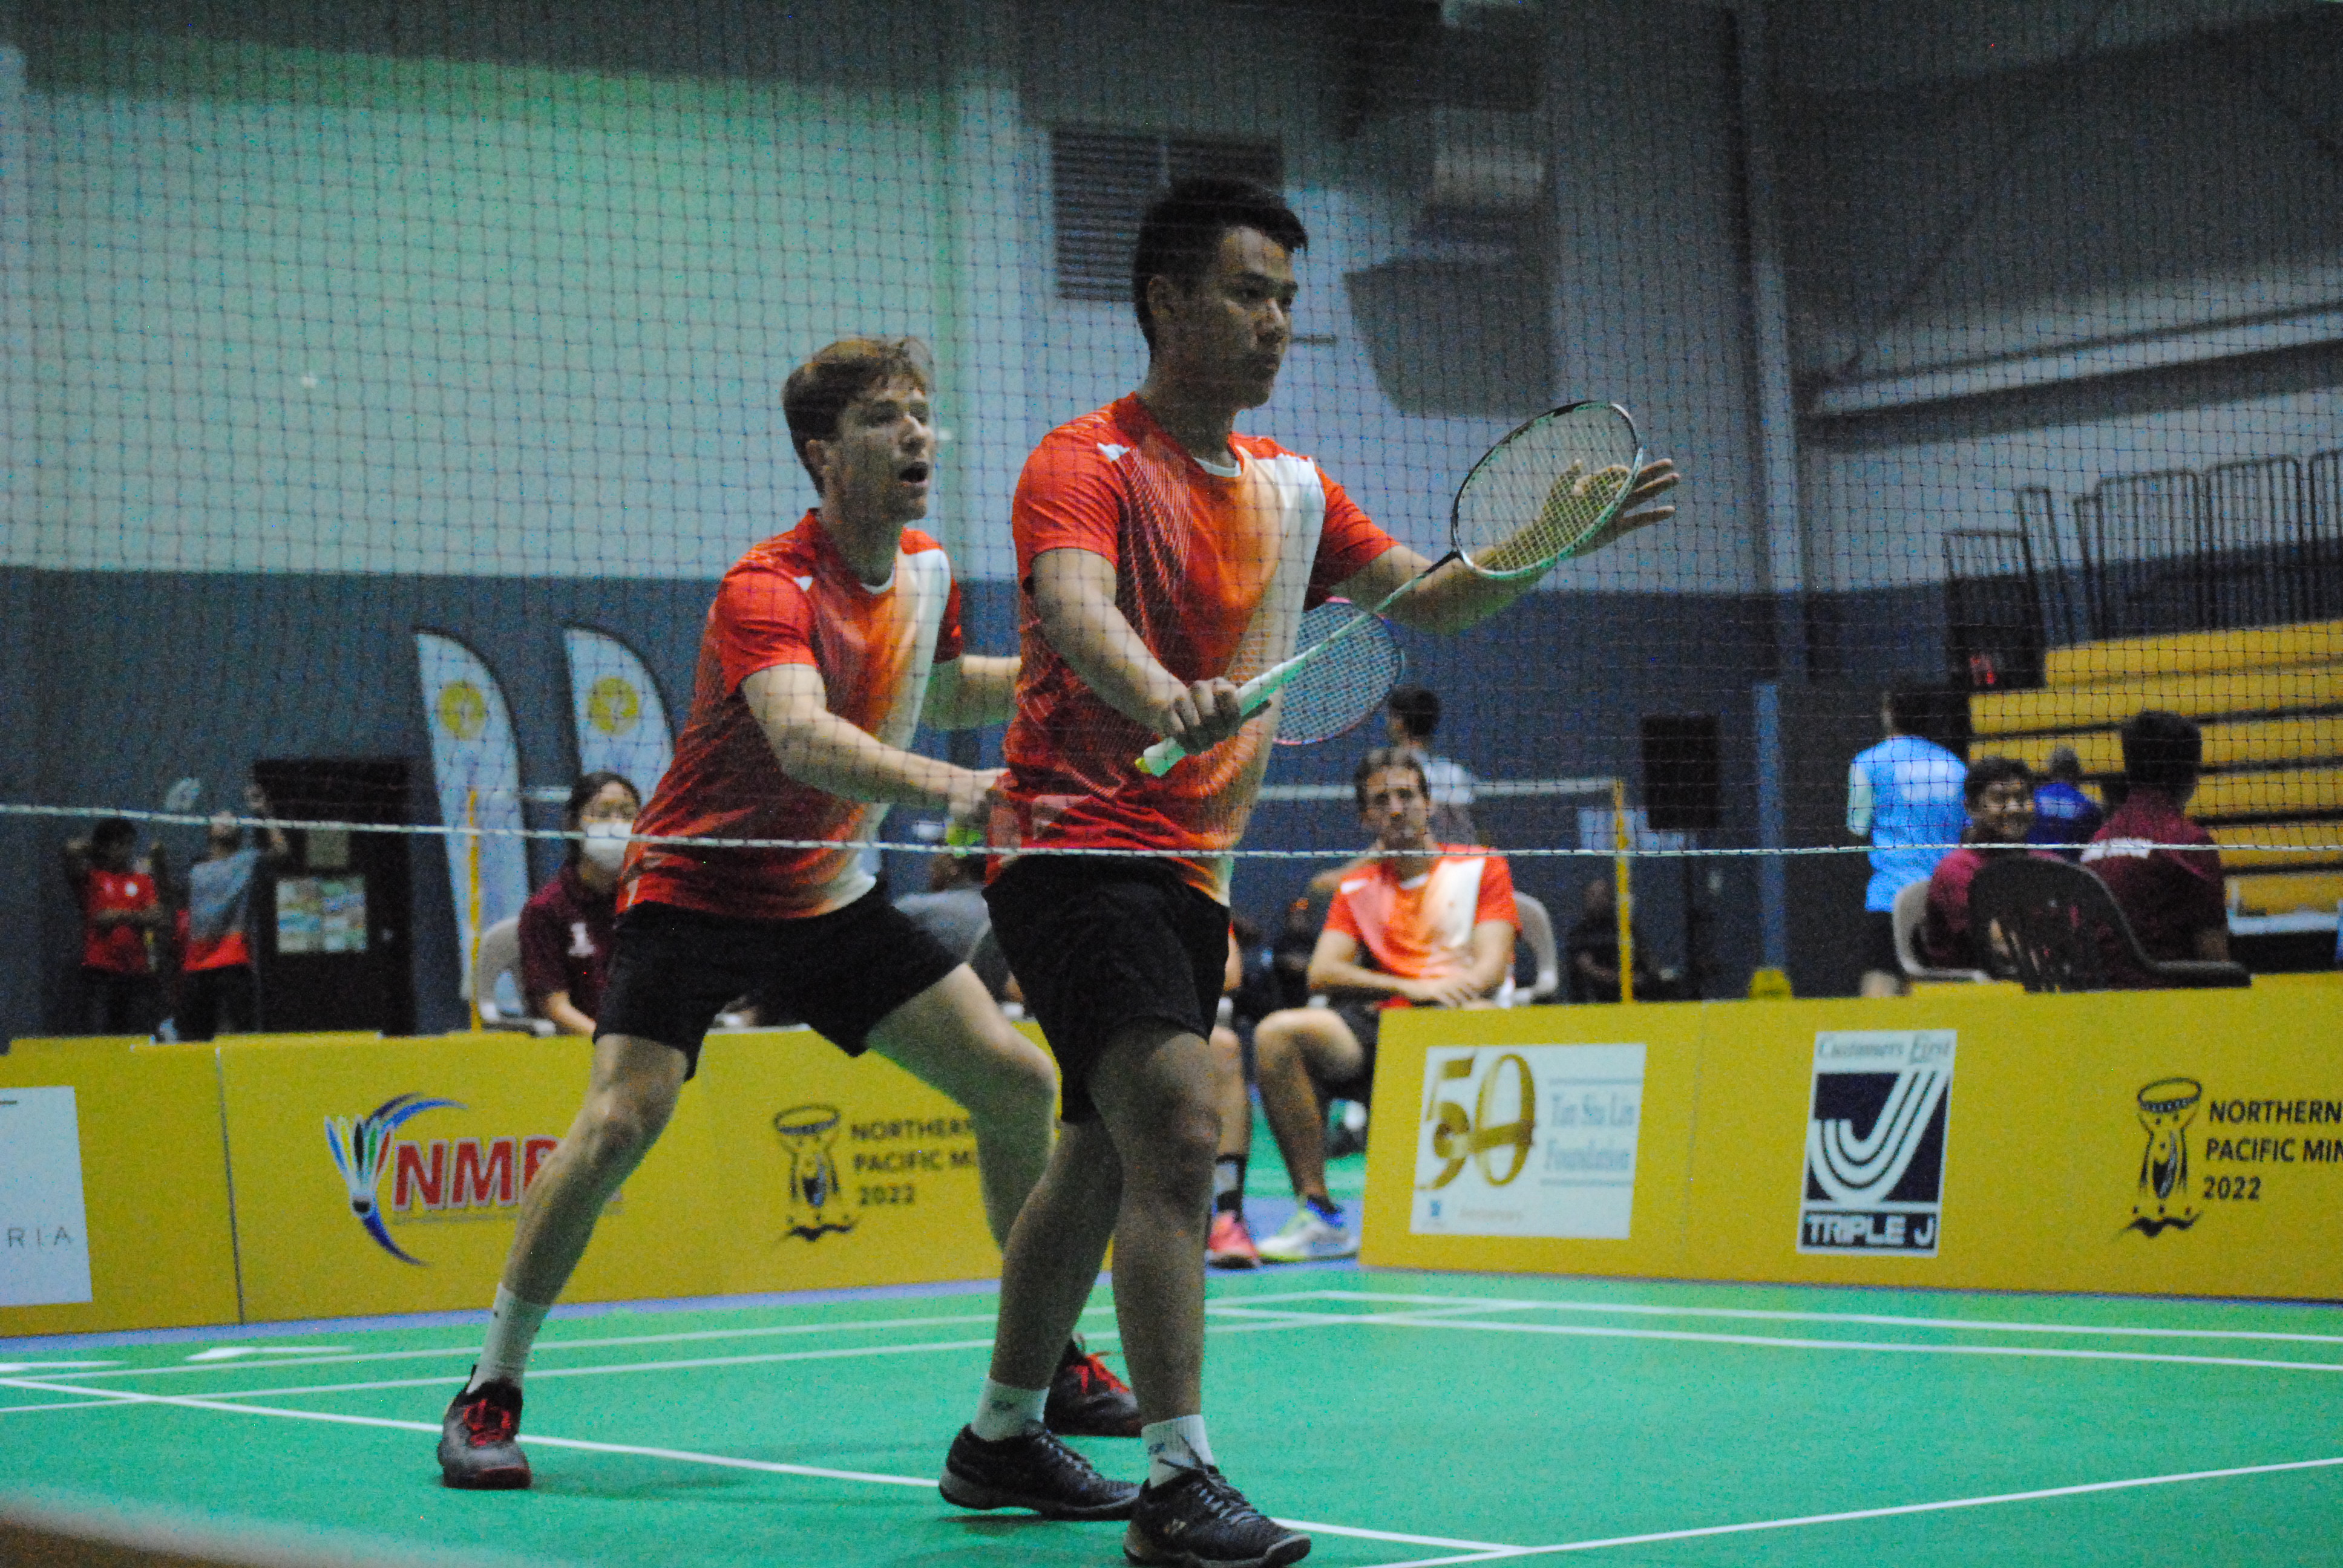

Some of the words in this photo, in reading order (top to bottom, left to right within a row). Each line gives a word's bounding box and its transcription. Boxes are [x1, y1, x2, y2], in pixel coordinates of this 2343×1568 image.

[2209, 1099, 2342, 1123] NORTHERN
[2206, 1137, 2296, 1162] PACIFIC
[2203, 1175, 2261, 1200] 2022
[1805, 1214, 1906, 1244] TRIPLE
[1913, 1214, 1935, 1246] J
